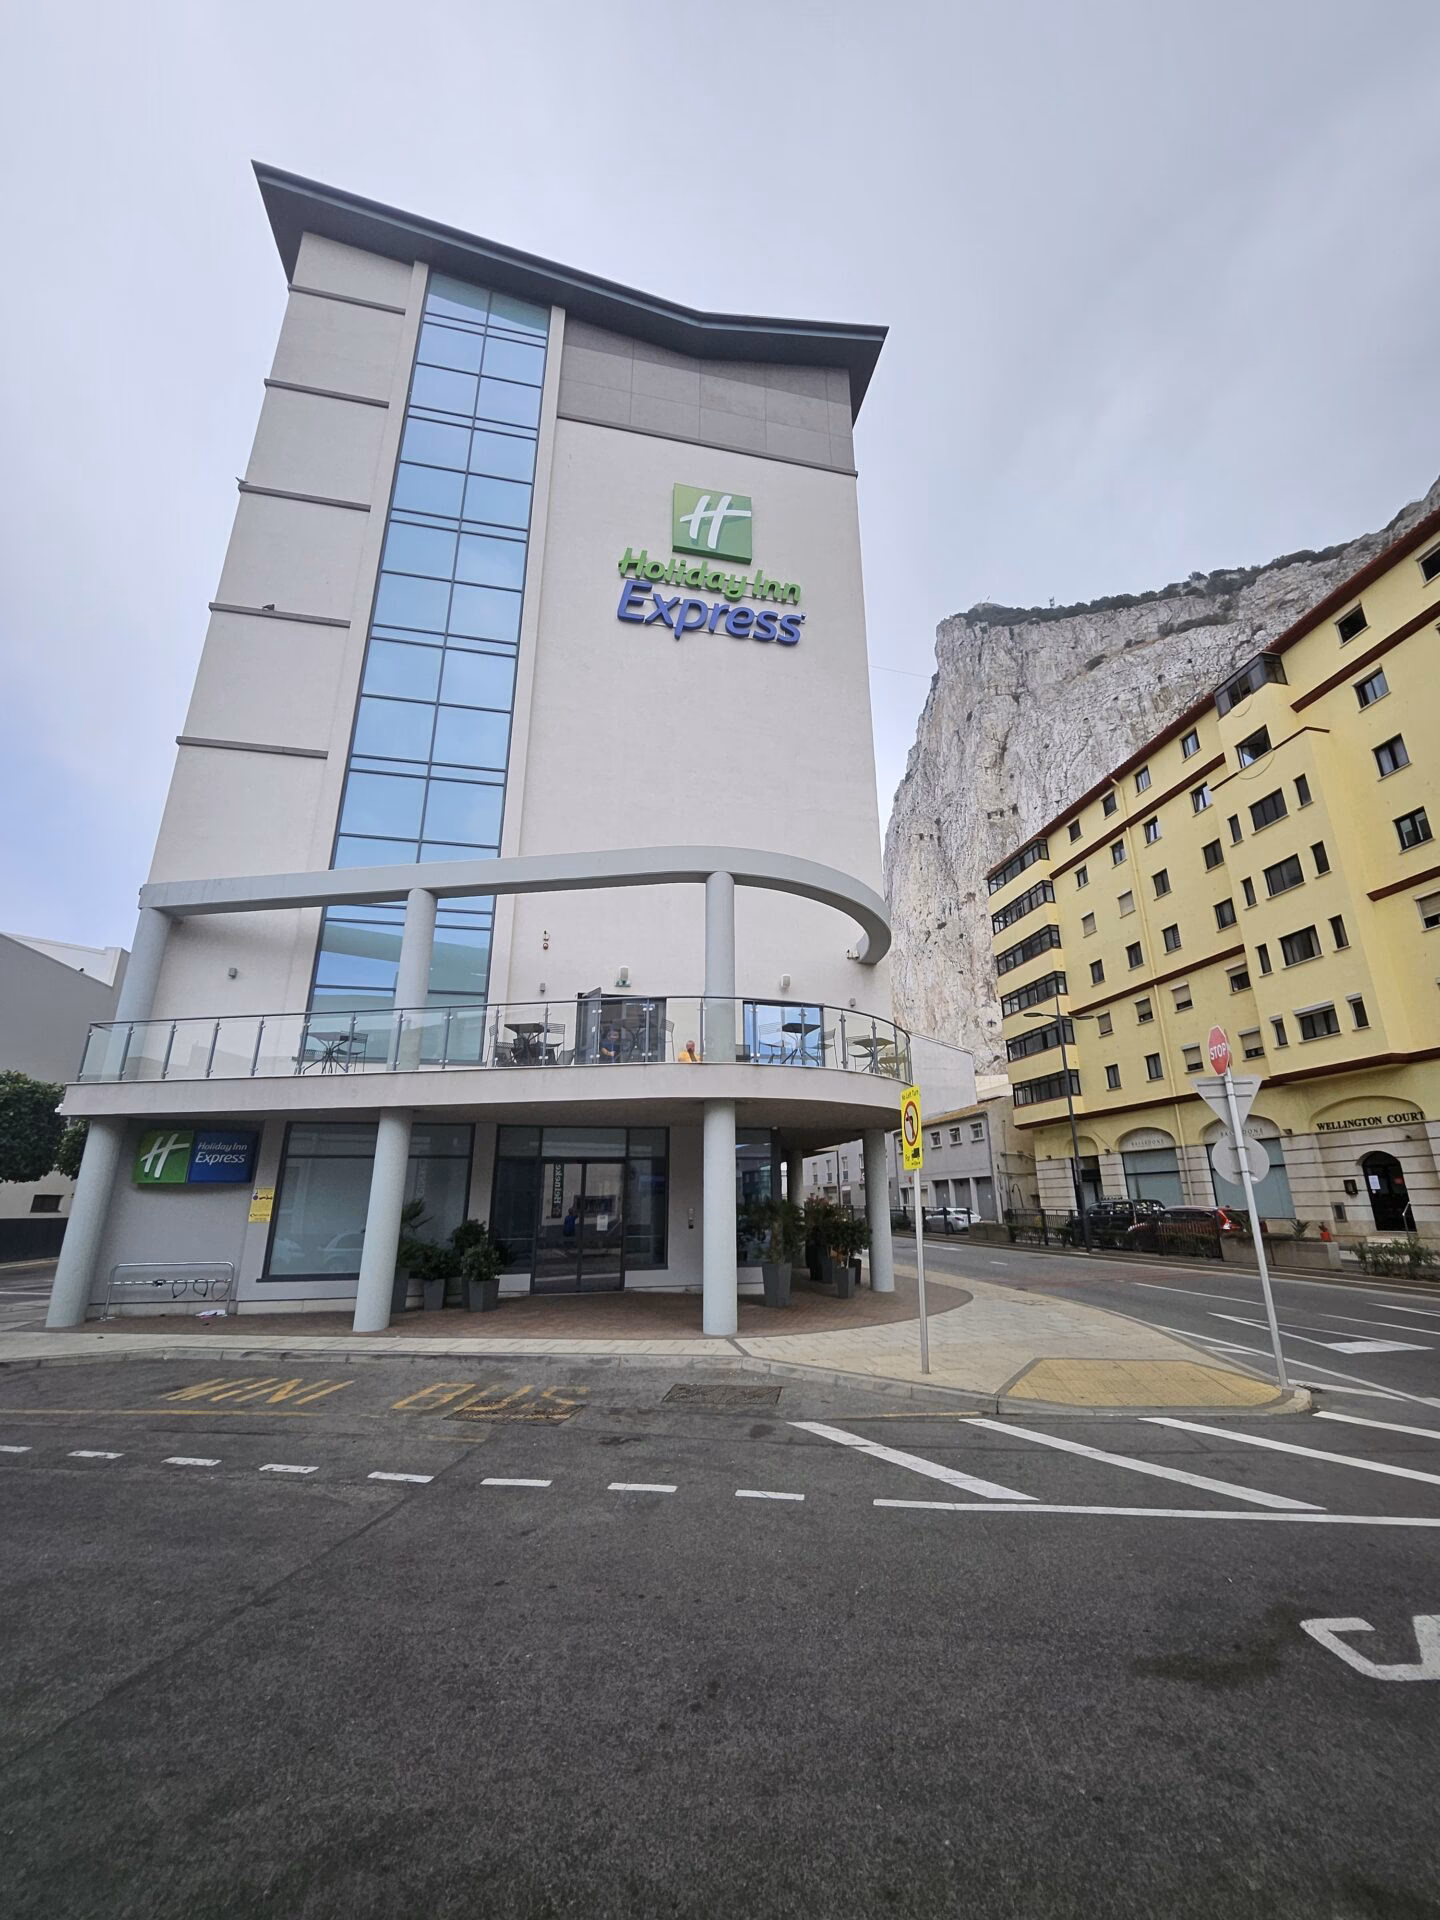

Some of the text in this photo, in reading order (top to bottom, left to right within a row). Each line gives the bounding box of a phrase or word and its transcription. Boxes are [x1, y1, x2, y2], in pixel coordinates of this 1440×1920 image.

[618, 547, 801, 605] Holiday Inn
[617, 579, 802, 646] Express
[1210, 1042, 1228, 1061] STOP
[1316, 1110, 1425, 1131] WELLINGTON COURT
[198, 1141, 248, 1152] Holiday Inn
[195, 1151, 246, 1166] Express
[158, 1378, 591, 1411] MINI BUS
